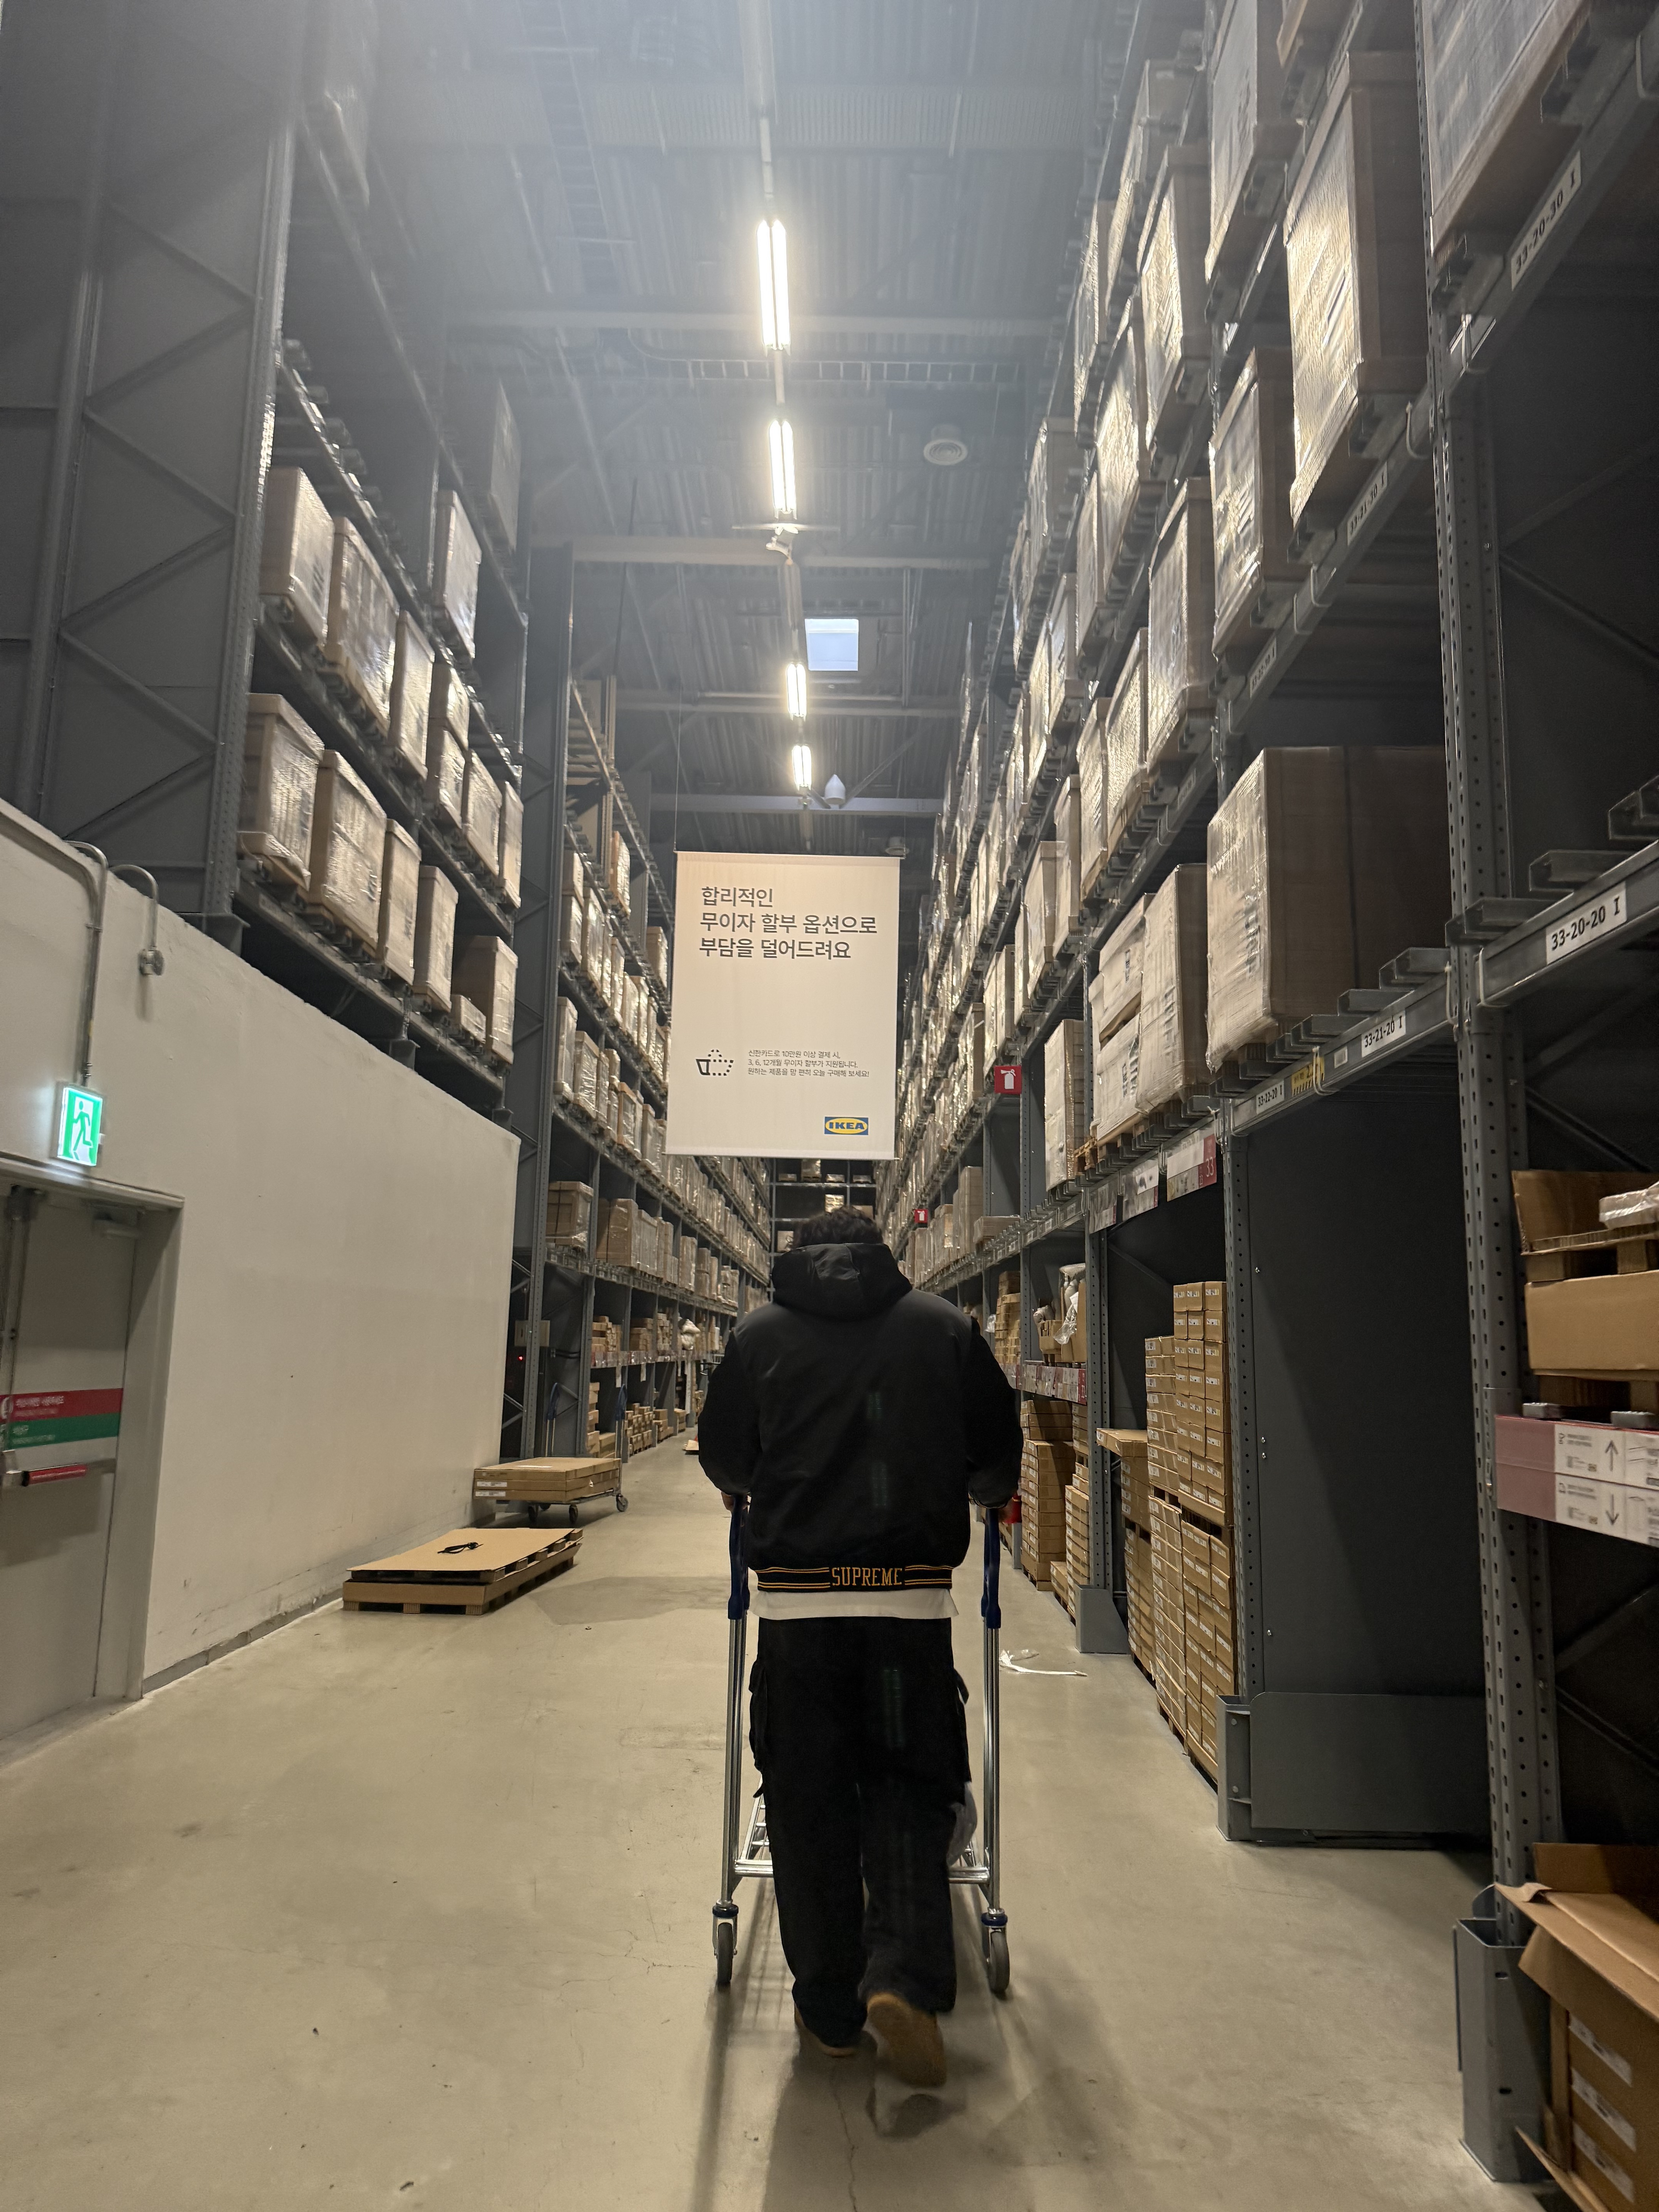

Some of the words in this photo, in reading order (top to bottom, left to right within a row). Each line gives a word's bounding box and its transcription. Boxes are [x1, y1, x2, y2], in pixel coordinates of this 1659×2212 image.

[1516, 188, 1563, 274] 33-20-30
[701, 886, 773, 907] 합리적인
[700, 912, 756, 932] 무이자
[761, 914, 797, 933] 할부
[803, 915, 877, 934] 옵션으로
[1551, 905, 1606, 951] 33-20-20
[699, 938, 754, 957] 부담을
[761, 939, 851, 960] 덜어드려요
[1365, 1020, 1395, 1048] 33-21-20
[1206, 1156, 1214, 1177] 33
[831, 1567, 903, 1586] SUPREME
